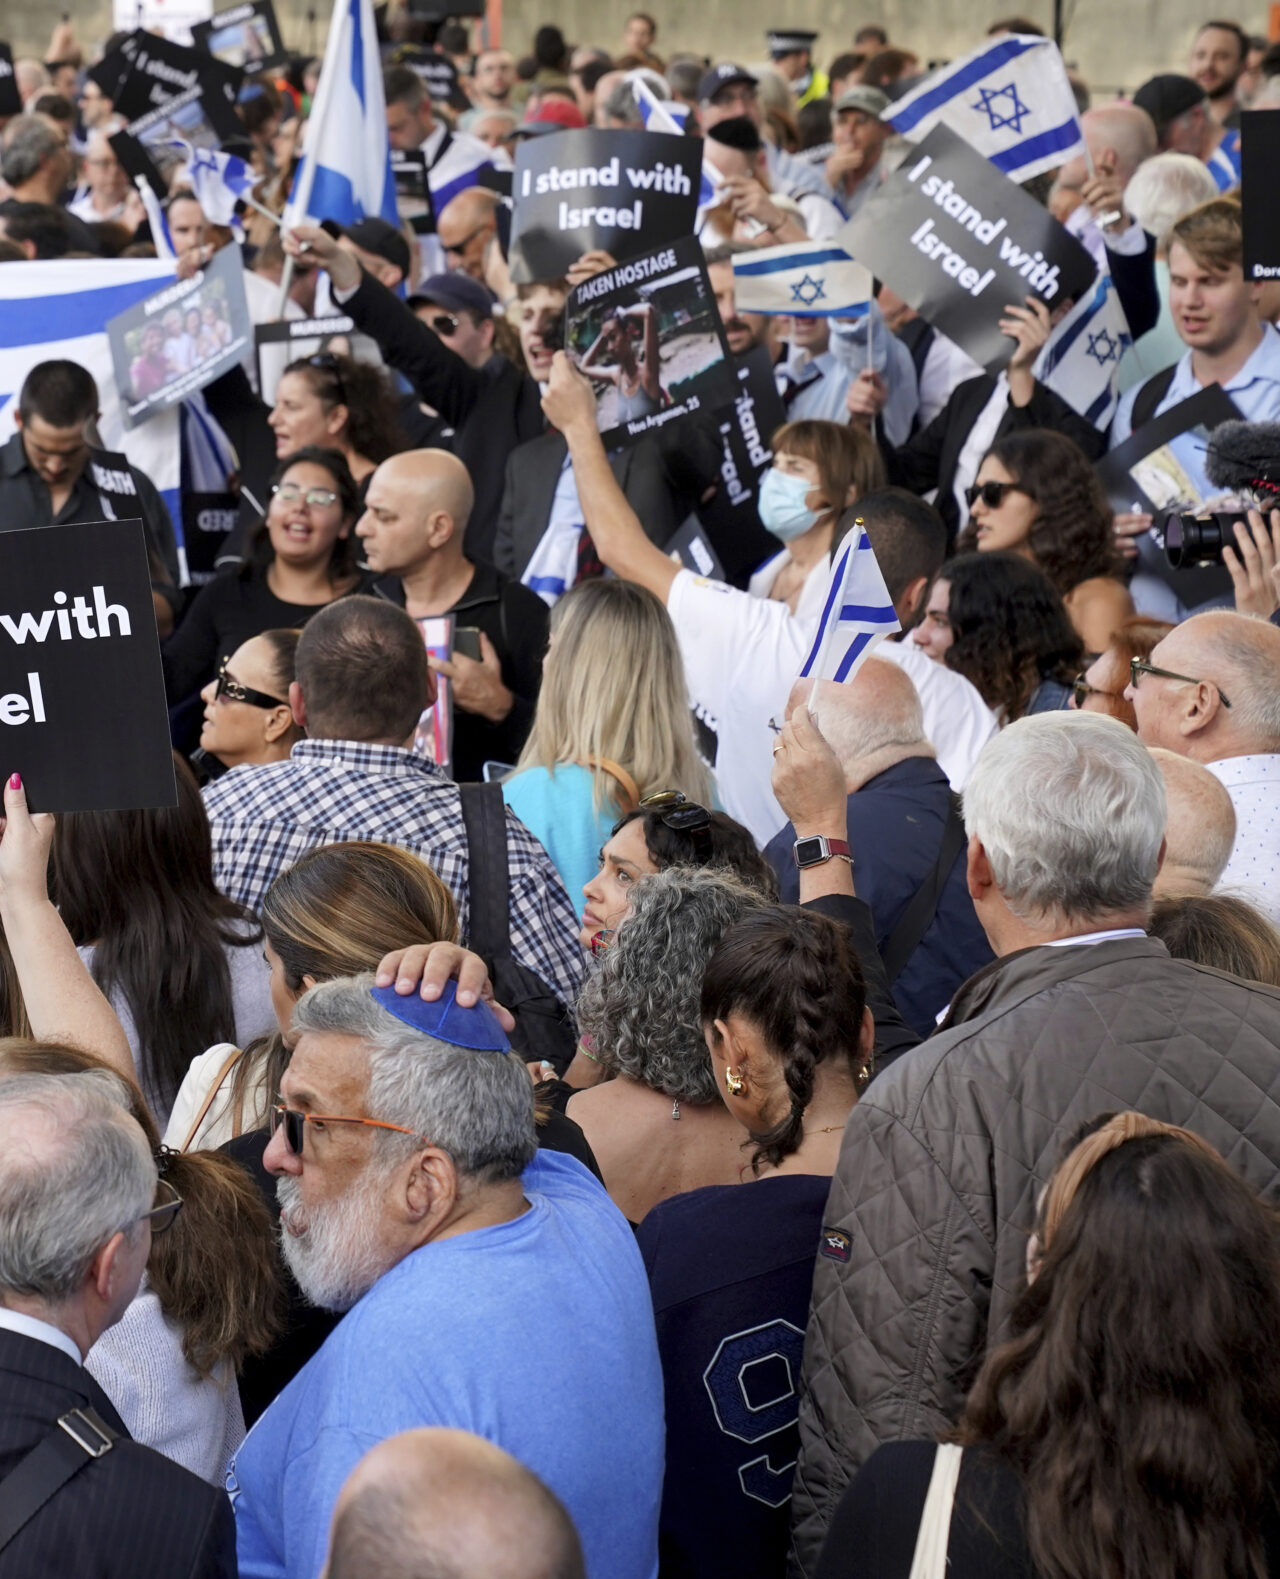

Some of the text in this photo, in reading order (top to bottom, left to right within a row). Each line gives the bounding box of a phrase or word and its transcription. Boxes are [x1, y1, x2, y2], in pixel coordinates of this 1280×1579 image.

[522, 157, 691, 197] I stand with
[558, 200, 643, 230] Israel
[907, 154, 1061, 300] I stand with
[577, 248, 677, 305] TAKEN HOSTAGE
[909, 217, 997, 297] Israel
[735, 386, 774, 468] tand
